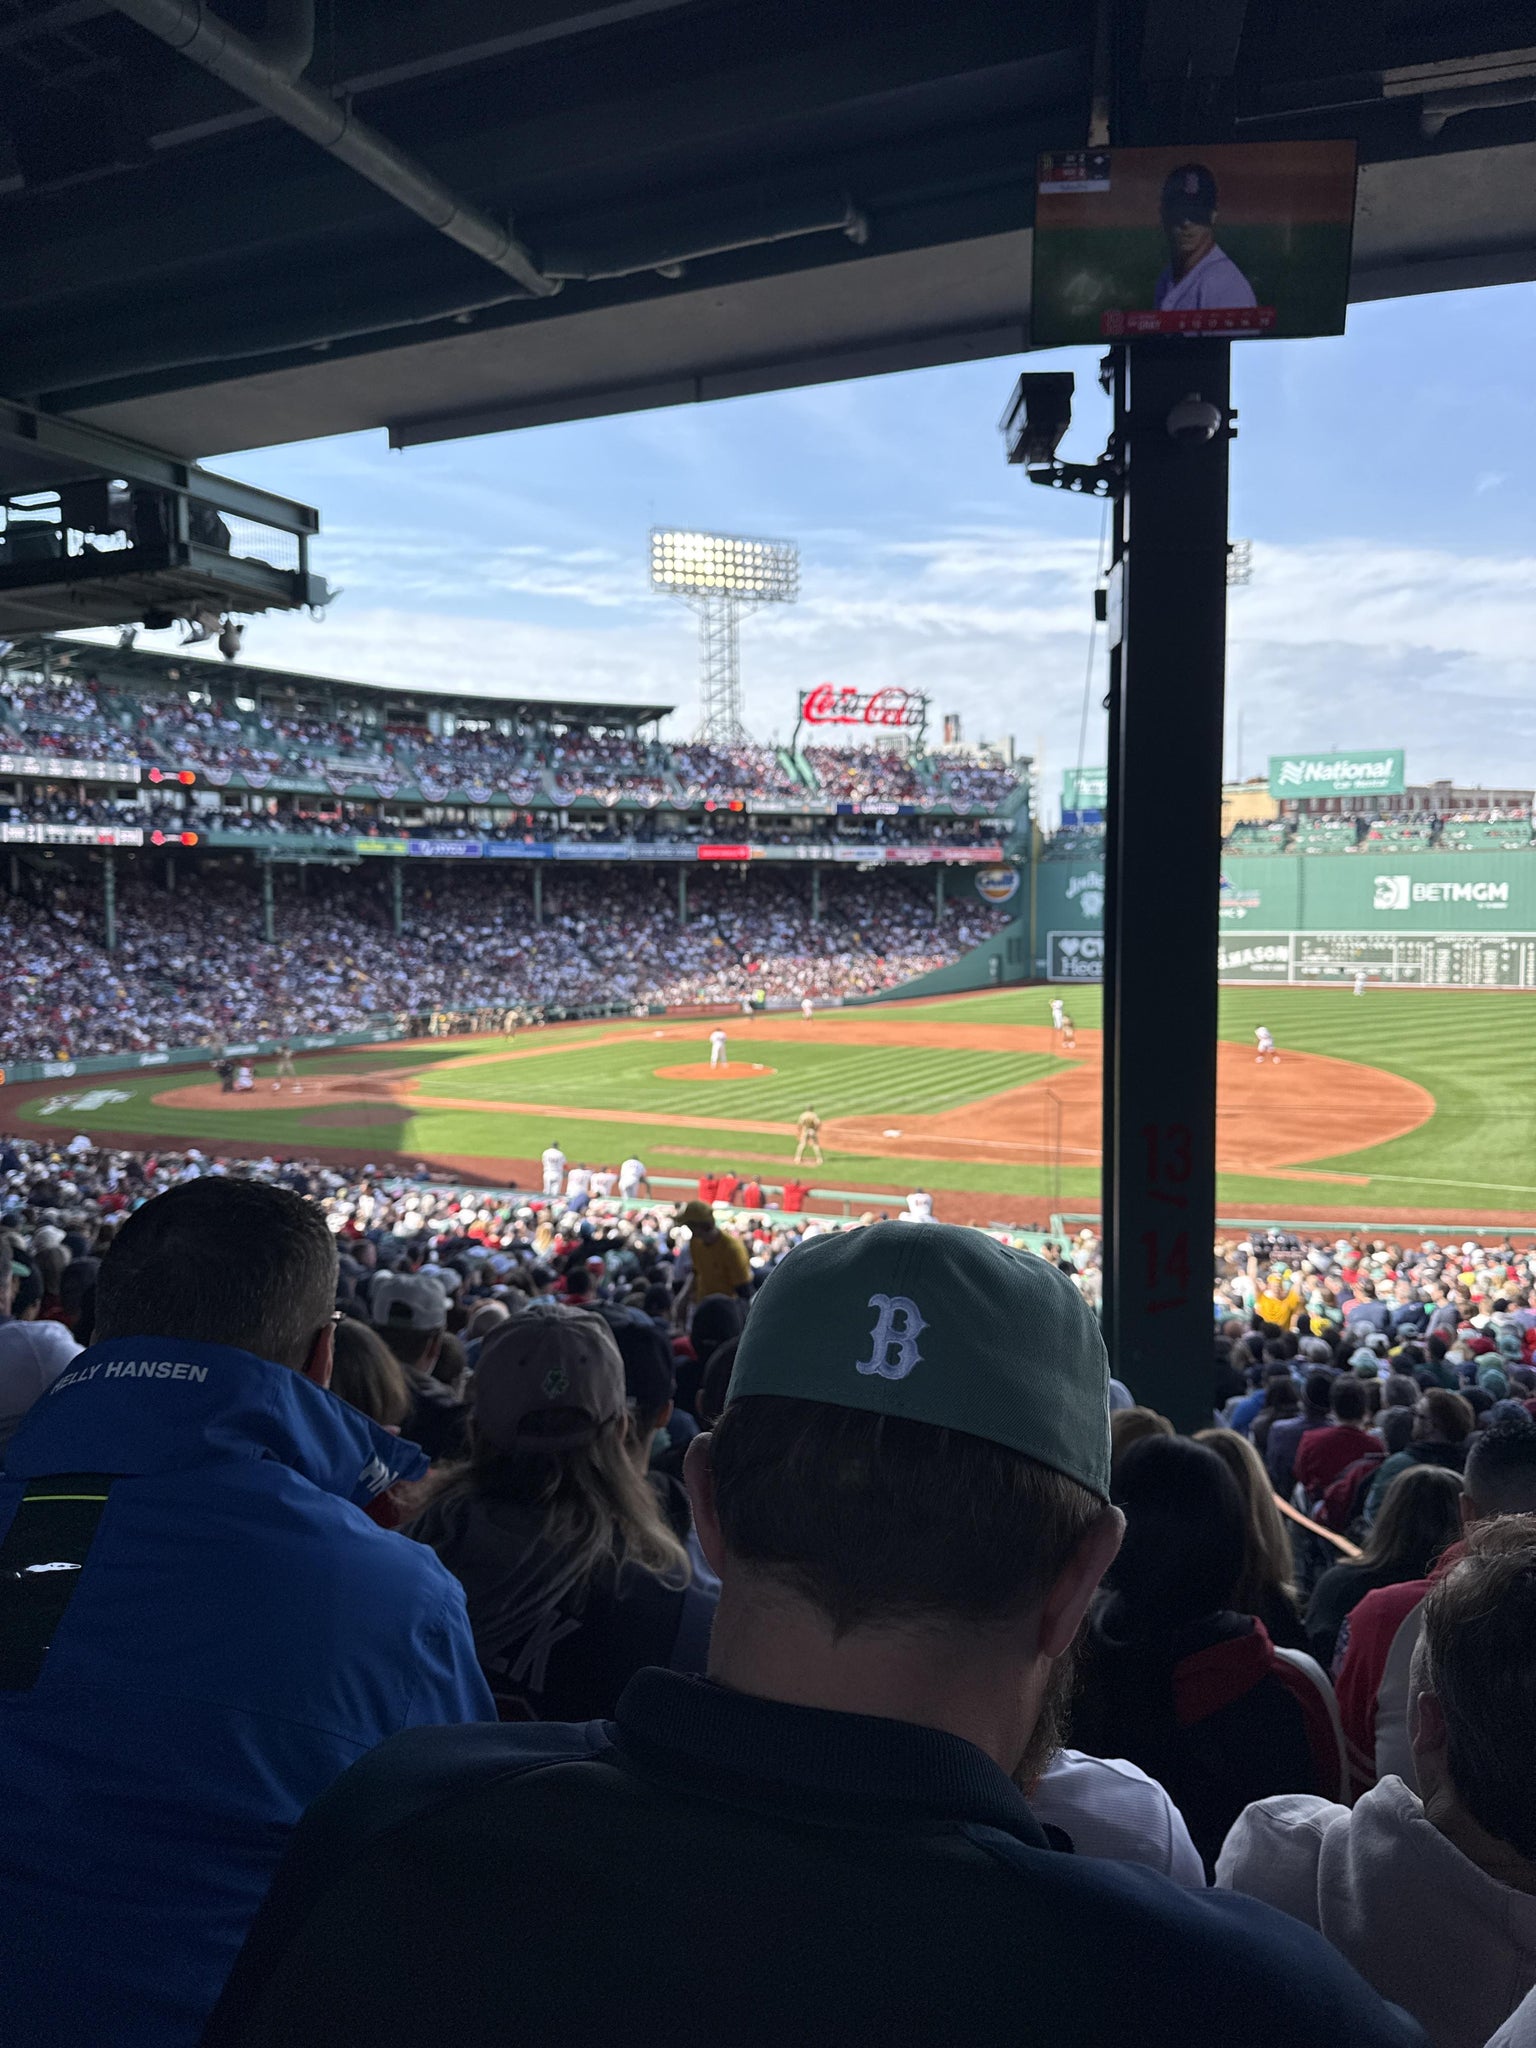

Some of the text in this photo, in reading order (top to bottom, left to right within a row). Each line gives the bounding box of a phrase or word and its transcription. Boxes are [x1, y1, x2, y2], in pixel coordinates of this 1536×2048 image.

[1304, 757, 1395, 782] National
[1412, 882, 1509, 902] BETMGM
[1142, 1123, 1193, 1183] 13
[1142, 1231, 1192, 1289] 14
[856, 1293, 930, 1379] B
[104, 1361, 209, 1383] HANSEN
